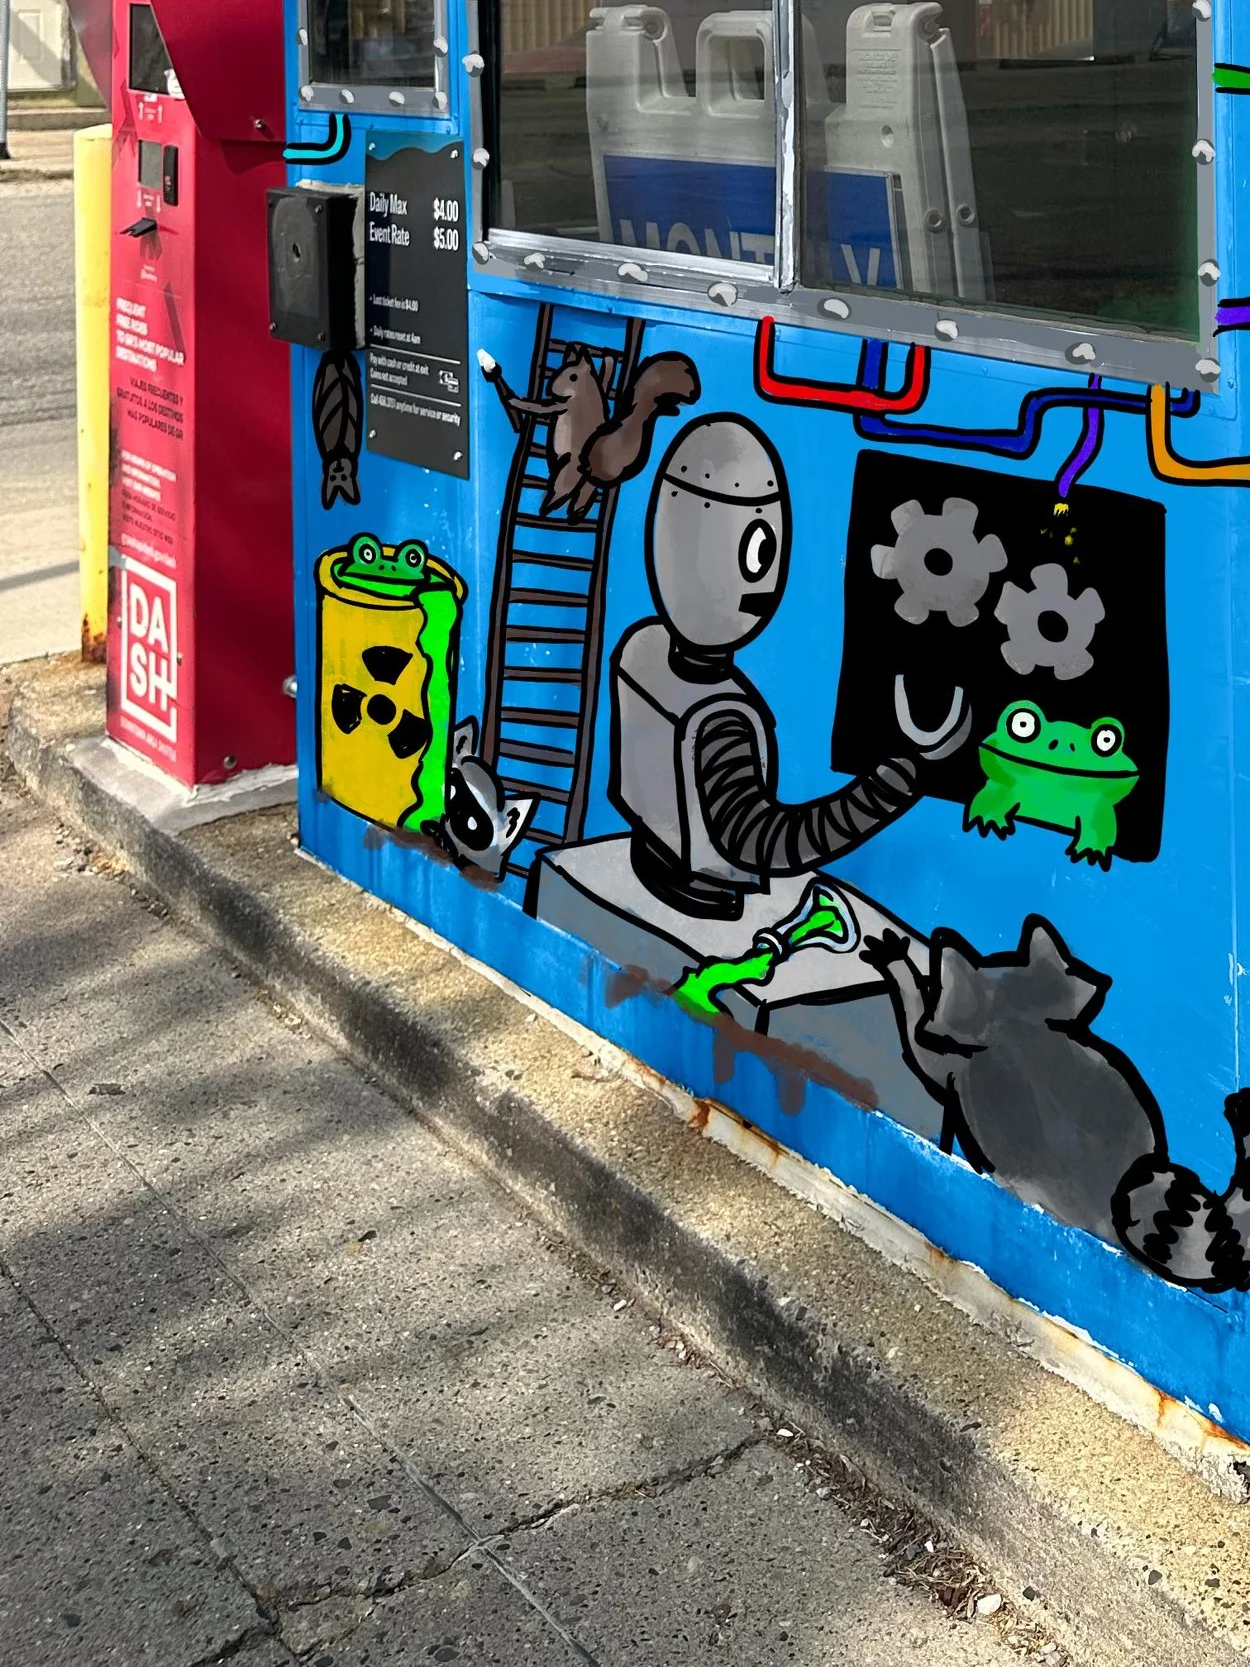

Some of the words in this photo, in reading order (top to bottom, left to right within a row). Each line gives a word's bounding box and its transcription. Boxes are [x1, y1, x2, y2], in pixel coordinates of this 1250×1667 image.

[369, 191, 389, 218] Daily
[390, 194, 408, 215] Max
[433, 197, 459, 222] $4.00
[369, 221, 391, 244] Event
[391, 223, 410, 247] Rate
[433, 226, 459, 251] $5.00
